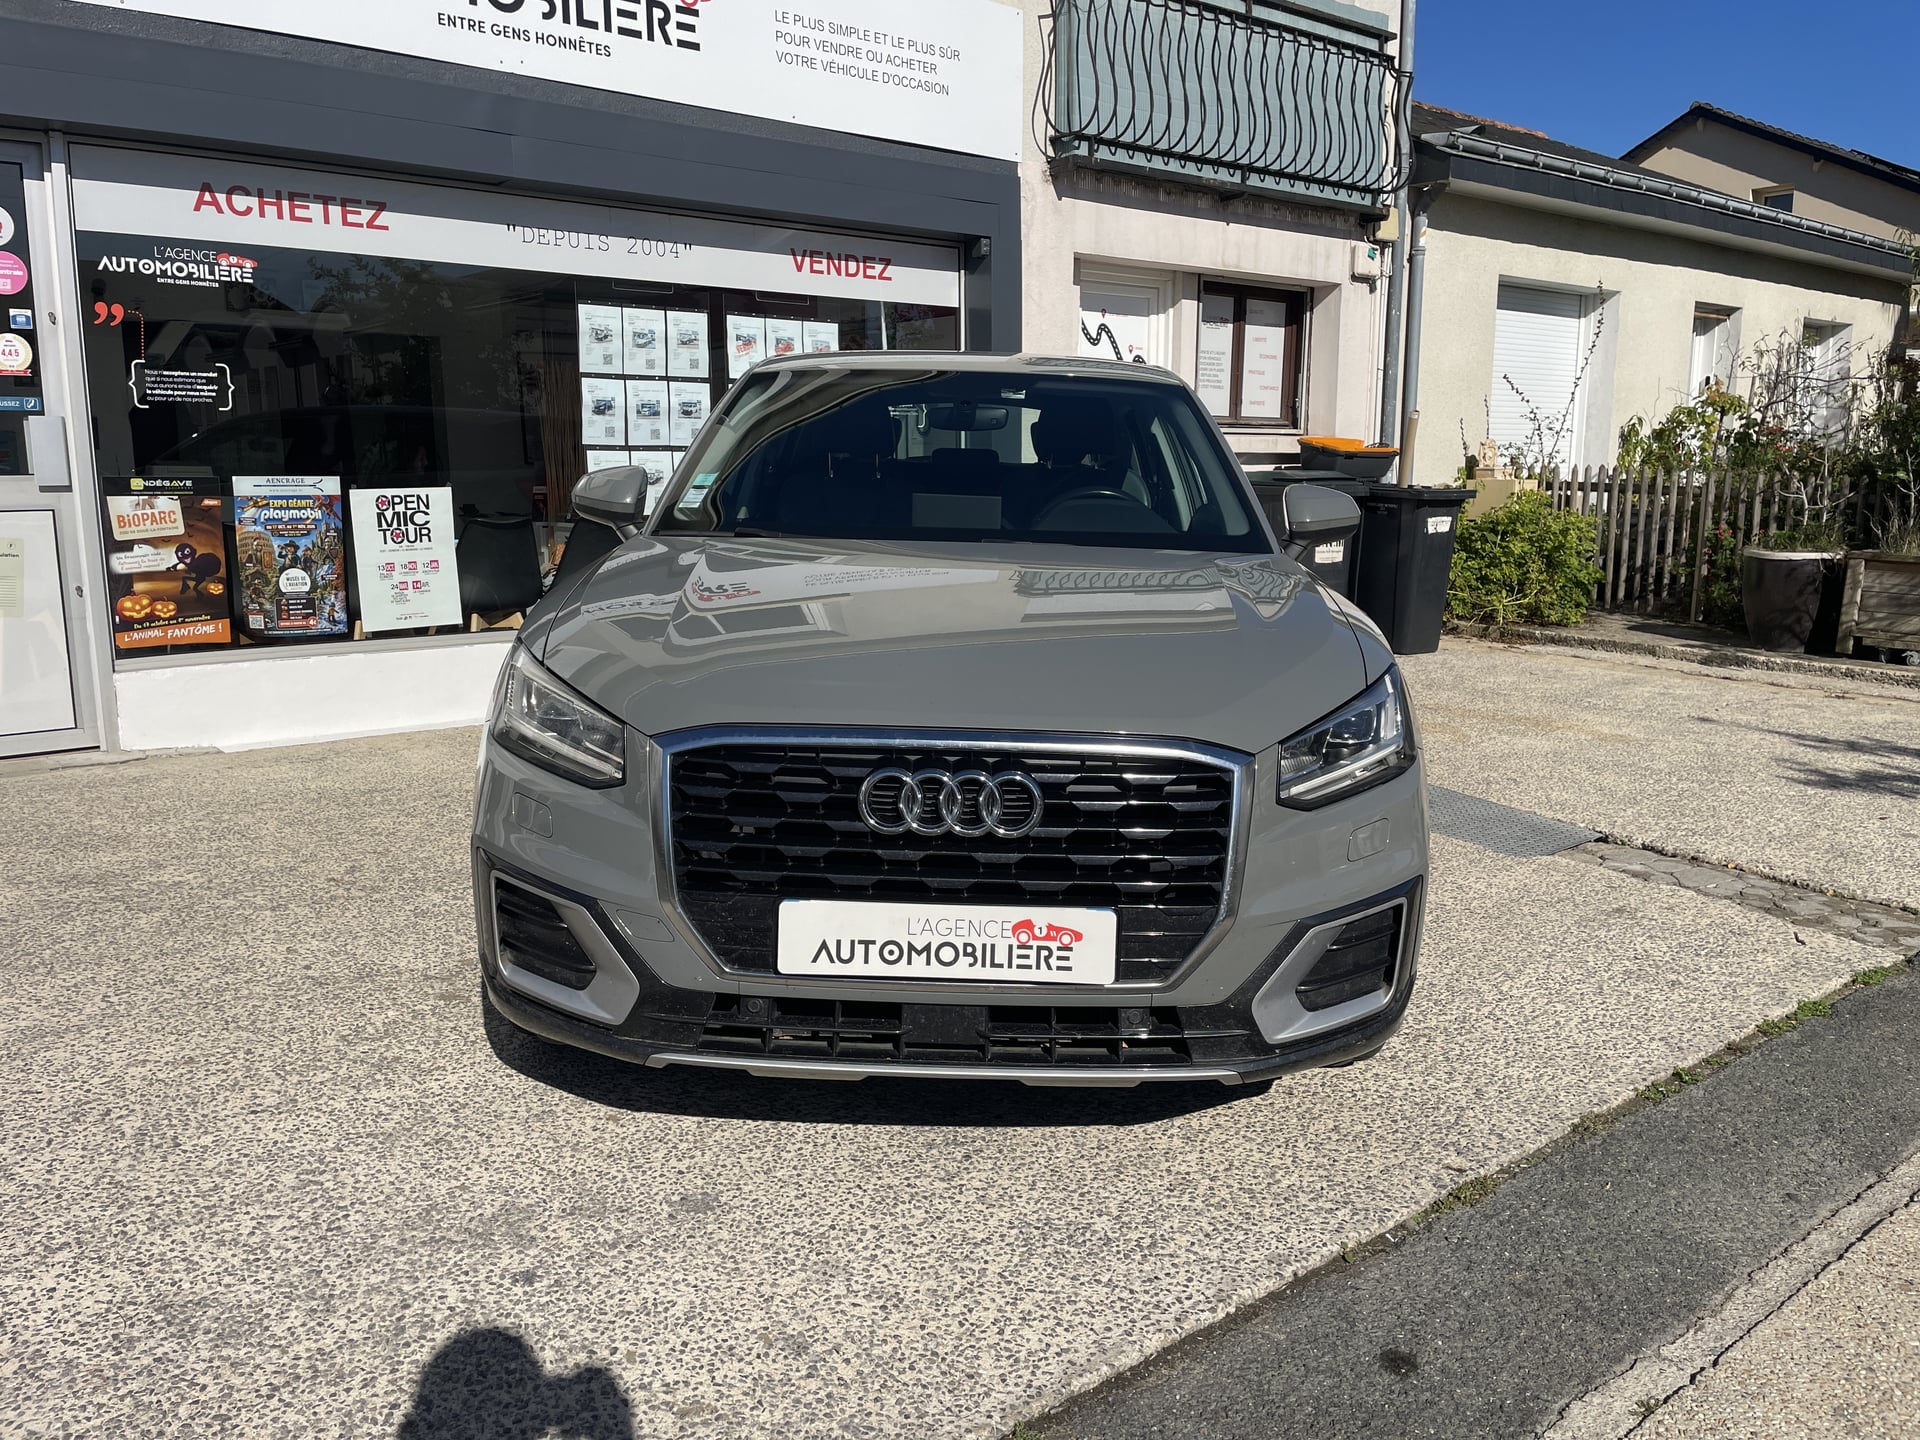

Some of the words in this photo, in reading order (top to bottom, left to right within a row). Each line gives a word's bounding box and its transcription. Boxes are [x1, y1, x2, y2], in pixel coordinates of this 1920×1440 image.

[438, 13, 486, 33] ENTRE
[491, 23, 531, 43] GENS
[536, 32, 612, 57] HONNÊTES
[775, 10, 790, 24] LE
[793, 14, 825, 32] PLUS
[828, 22, 871, 42] SIMPLE
[874, 31, 889, 45] ET
[892, 35, 905, 49] LE
[908, 40, 936, 56] PLUS
[938, 46, 961, 61] SÛR
[775, 30, 811, 48] POUR
[813, 38, 863, 60] VENDRE
[866, 50, 883, 63] OU
[885, 54, 938, 75] ACHETER
[775, 50, 818, 70] VOTRE
[821, 59, 879, 82] VÉHICULE
[882, 72, 949, 96] D'OCCASION
[193, 182, 390, 231] ACHETEZ
[506, 223, 610, 252] "DEPUIS
[626, 236, 692, 259] 2004"
[154, 246, 217, 263] L'AGENCE
[790, 248, 893, 281] VENDEZ
[269, 499, 288, 507] EXPO
[288, 498, 314, 507] GÉANTE
[375, 493, 431, 512] OPEN
[260, 508, 322, 522] playmobil
[376, 510, 431, 528] MIC
[378, 527, 432, 545] TOUR
[124, 629, 165, 642] L'ANIMAL
[167, 623, 216, 639] FANTÔME
[907, 917, 1012, 939] L'AGENCE
